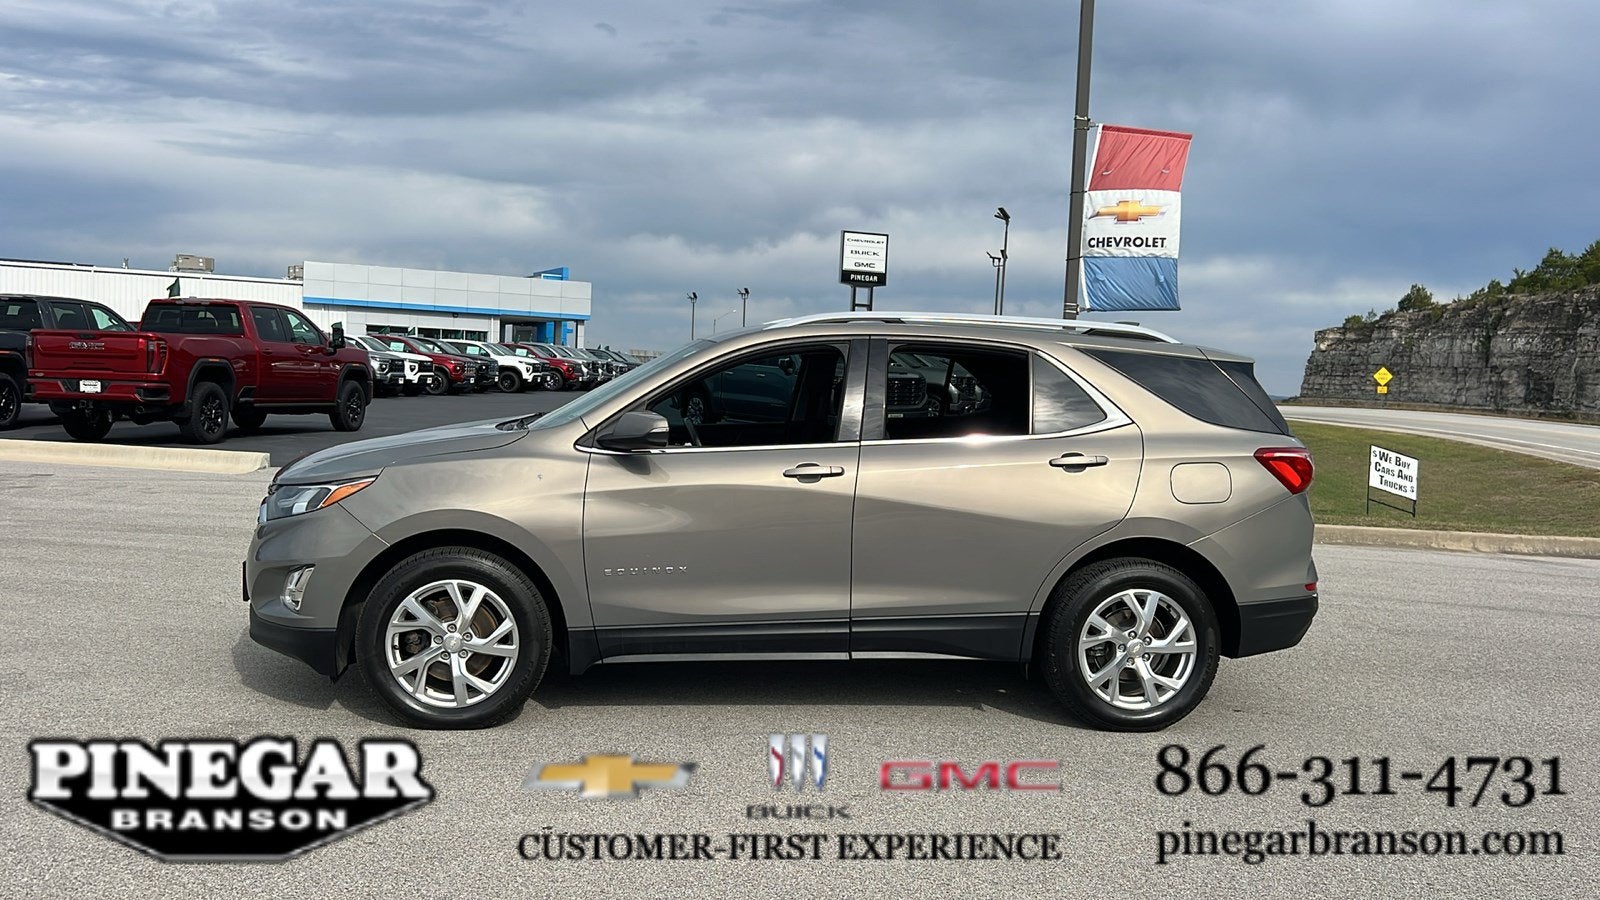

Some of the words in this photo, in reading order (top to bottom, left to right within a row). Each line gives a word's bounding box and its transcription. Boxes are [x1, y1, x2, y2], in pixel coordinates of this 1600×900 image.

[1088, 236, 1167, 248] CHEVROLET
[850, 274, 878, 282] PINEGAR
[604, 566, 687, 576] EQUINOX
